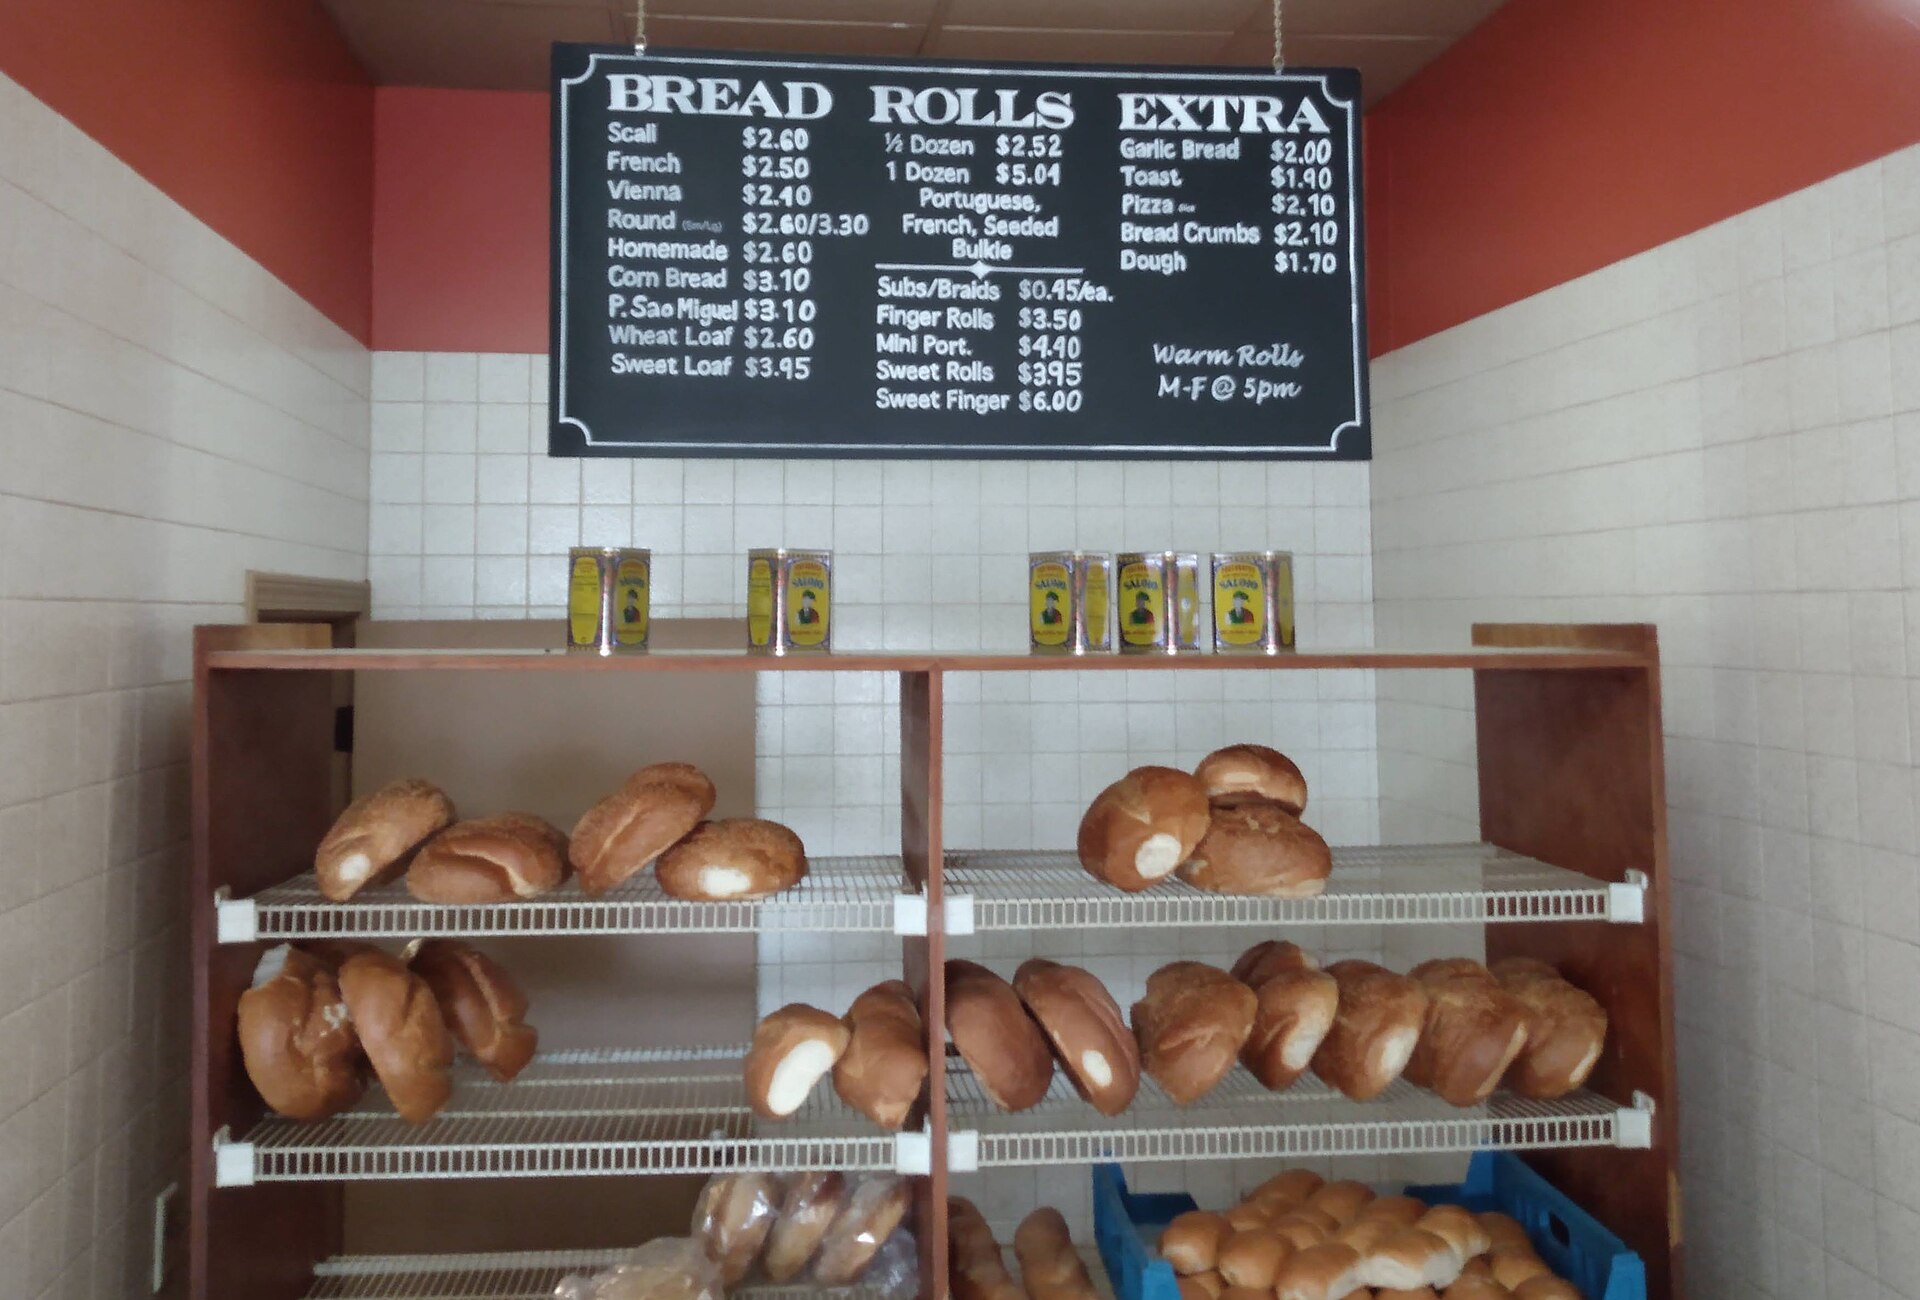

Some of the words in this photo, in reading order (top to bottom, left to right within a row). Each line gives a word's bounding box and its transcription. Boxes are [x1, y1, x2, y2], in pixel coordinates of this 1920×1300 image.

[606, 74, 833, 119] BREAD
[869, 85, 1075, 129] ROLLS
[1117, 93, 1330, 133] EXTRA
[743, 126, 809, 151] $2.60
[910, 134, 975, 156] Dozen
[996, 134, 1063, 157] $2.52
[1120, 138, 1176, 160] Garlic
[1182, 137, 1240, 160] Bread
[1270, 138, 1332, 165] $2.00
[607, 150, 682, 174] French
[743, 155, 810, 179] $2.50
[886, 161, 896, 181] 1
[906, 161, 970, 183] Dozen
[996, 162, 1061, 186] $5.04
[1120, 165, 1184, 187] Toast
[1270, 165, 1332, 191] $1.90
[607, 179, 683, 202] Vienna
[743, 183, 812, 206] $2.40
[919, 187, 1042, 214] Portuguese,
[1122, 193, 1174, 215] Pizza
[1271, 193, 1335, 217] $2.10
[607, 209, 676, 231] Round
[743, 212, 870, 235] $2.60/3.30
[902, 213, 978, 237] French,
[984, 215, 1059, 237] Seeded
[1120, 222, 1179, 243] Bread
[1183, 222, 1261, 245] Crumbs
[1274, 220, 1338, 246] $2.10
[607, 238, 728, 261] Homemade
[743, 240, 813, 264] $2.60
[952, 238, 1013, 260] Bulkie
[1120, 249, 1187, 275] Dough
[1275, 250, 1337, 274] $1.70
[607, 264, 659, 288] Corn
[665, 267, 728, 289] Bread
[743, 268, 810, 292] $3.10
[877, 276, 1001, 301] Subs/Braids
[677, 297, 739, 326] Miguel
[744, 298, 816, 323] $3.10
[876, 304, 942, 330] Finger
[947, 307, 995, 331] Rolls
[1019, 307, 1082, 331] $3.50
[608, 325, 678, 345] Wheat
[685, 326, 735, 346] Loaf
[744, 326, 815, 350] $2.60
[876, 333, 917, 354] Mini
[923, 334, 973, 356] Port.
[1018, 335, 1081, 359] $4.40
[611, 353, 678, 375] Sweet
[684, 355, 734, 375] Loaf
[744, 356, 812, 380] $3.95
[1153, 343, 1234, 366] Warm
[1236, 343, 1304, 368] Rolls
[876, 360, 941, 381] Sweet
[946, 361, 994, 382] Rolls
[876, 387, 941, 409] Sweet
[946, 389, 1010, 415] Finger
[1018, 389, 1082, 412] $6.00
[1157, 374, 1207, 401] M-F
[1211, 375, 1236, 401] @
[1243, 377, 1302, 405] 5pm
